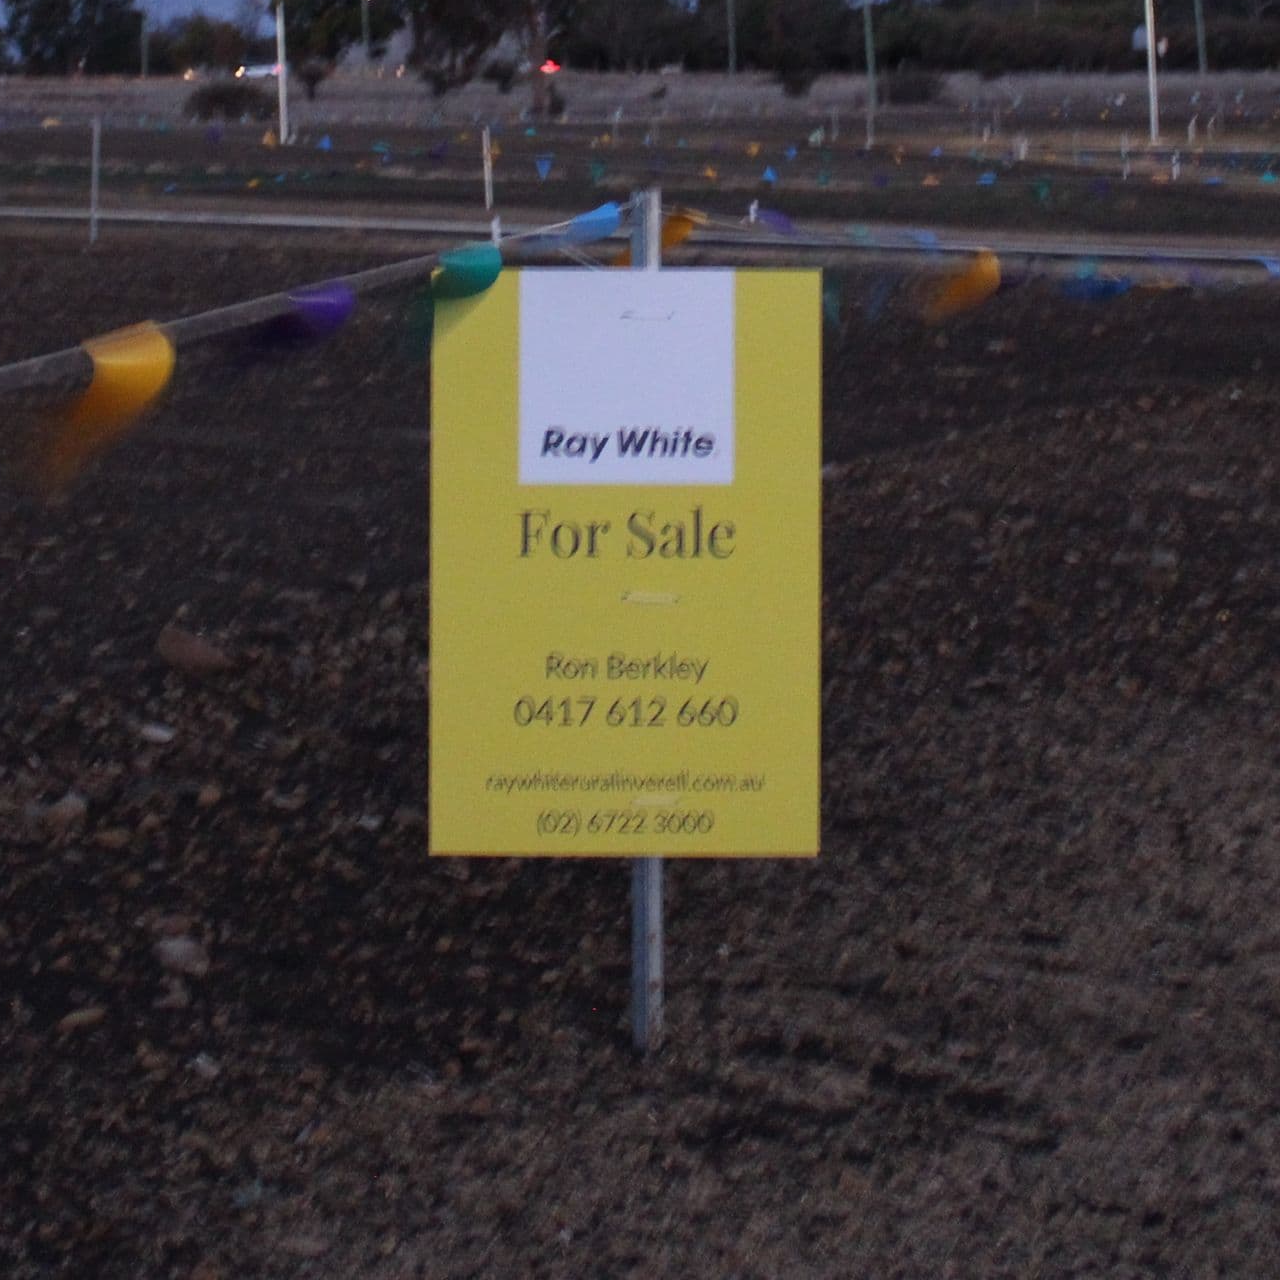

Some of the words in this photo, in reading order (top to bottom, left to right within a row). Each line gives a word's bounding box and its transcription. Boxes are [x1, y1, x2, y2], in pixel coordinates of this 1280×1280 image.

[541, 428, 609, 463] Ray
[618, 426, 714, 457] White
[517, 508, 611, 558] For
[626, 506, 737, 558] Sale
[545, 652, 597, 680] Ron
[607, 652, 709, 684] Berkley
[514, 695, 597, 727] 0417
[606, 696, 666, 727] 612
[677, 696, 740, 728] 660
[537, 809, 581, 837] (02)
[587, 810, 645, 835] 6722
[653, 810, 715, 835] 3000
